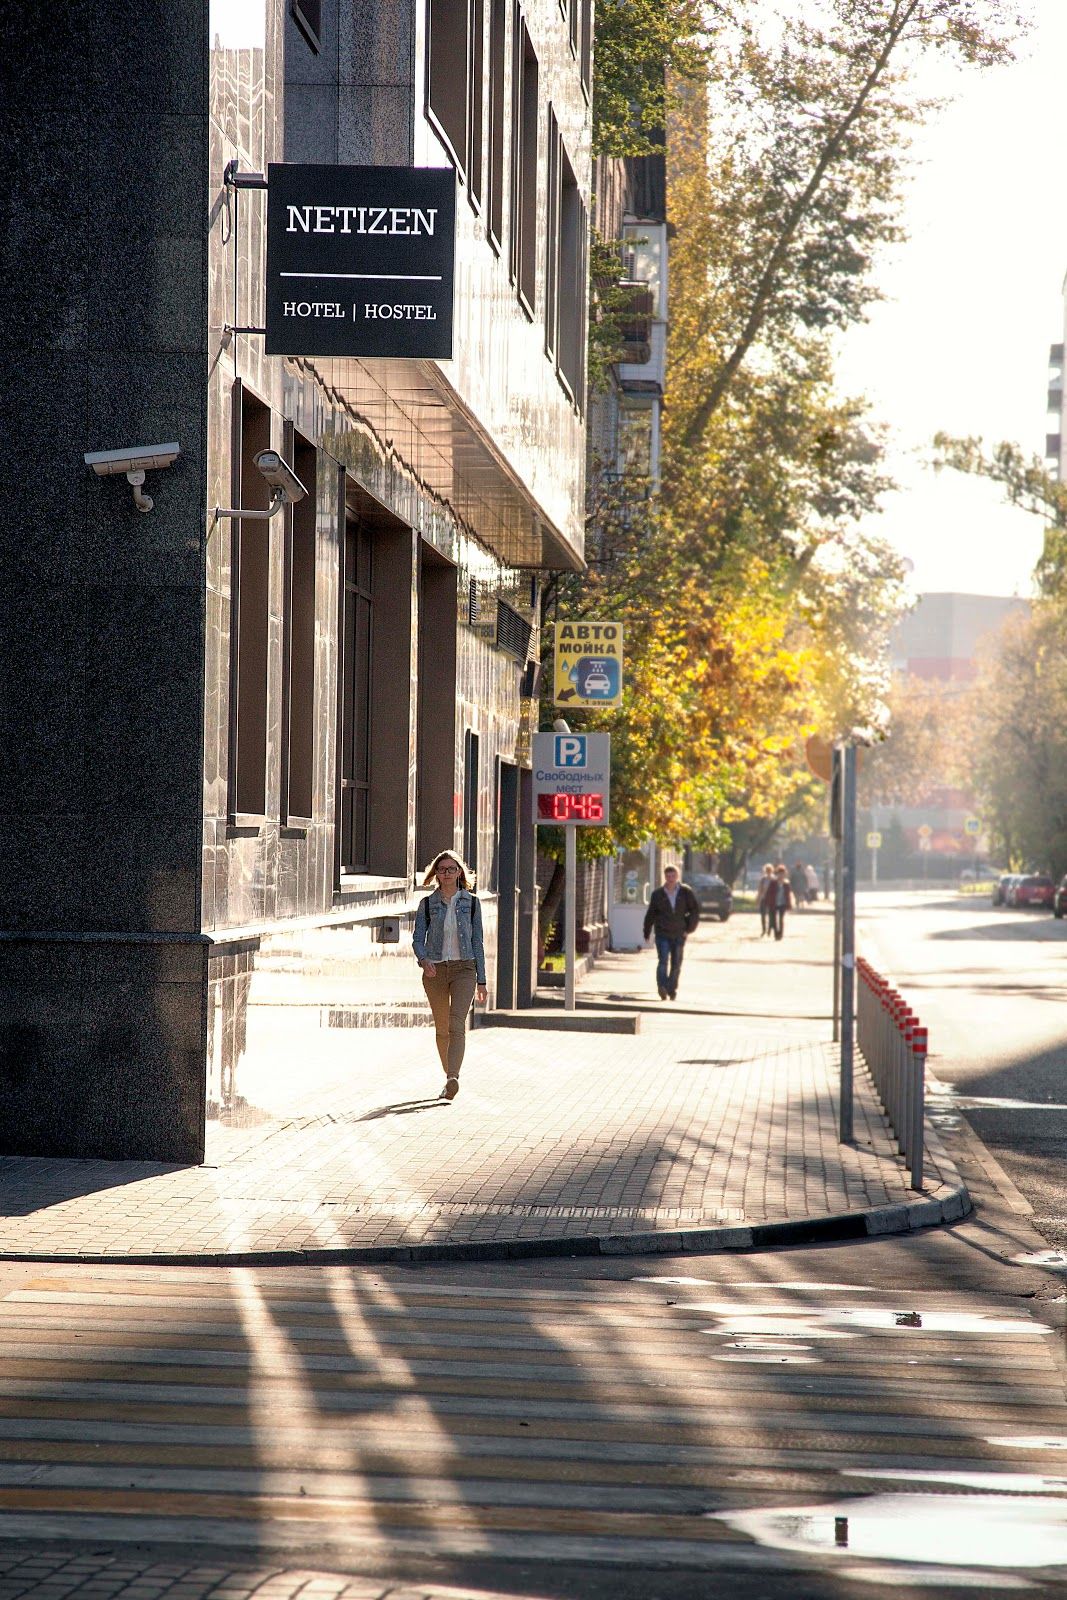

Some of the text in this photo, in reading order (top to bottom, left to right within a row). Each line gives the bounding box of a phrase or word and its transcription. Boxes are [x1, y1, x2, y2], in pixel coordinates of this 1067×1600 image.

[285, 205, 438, 236] NETIZEN
[283, 302, 345, 318] HOTEL
[364, 304, 437, 320] HOSTEL
[560, 625, 617, 639] АВТО
[559, 641, 616, 654] МОЙКА
[536, 770, 604, 782] Свободных
[556, 785, 583, 793] мест
[554, 793, 603, 820] 046
